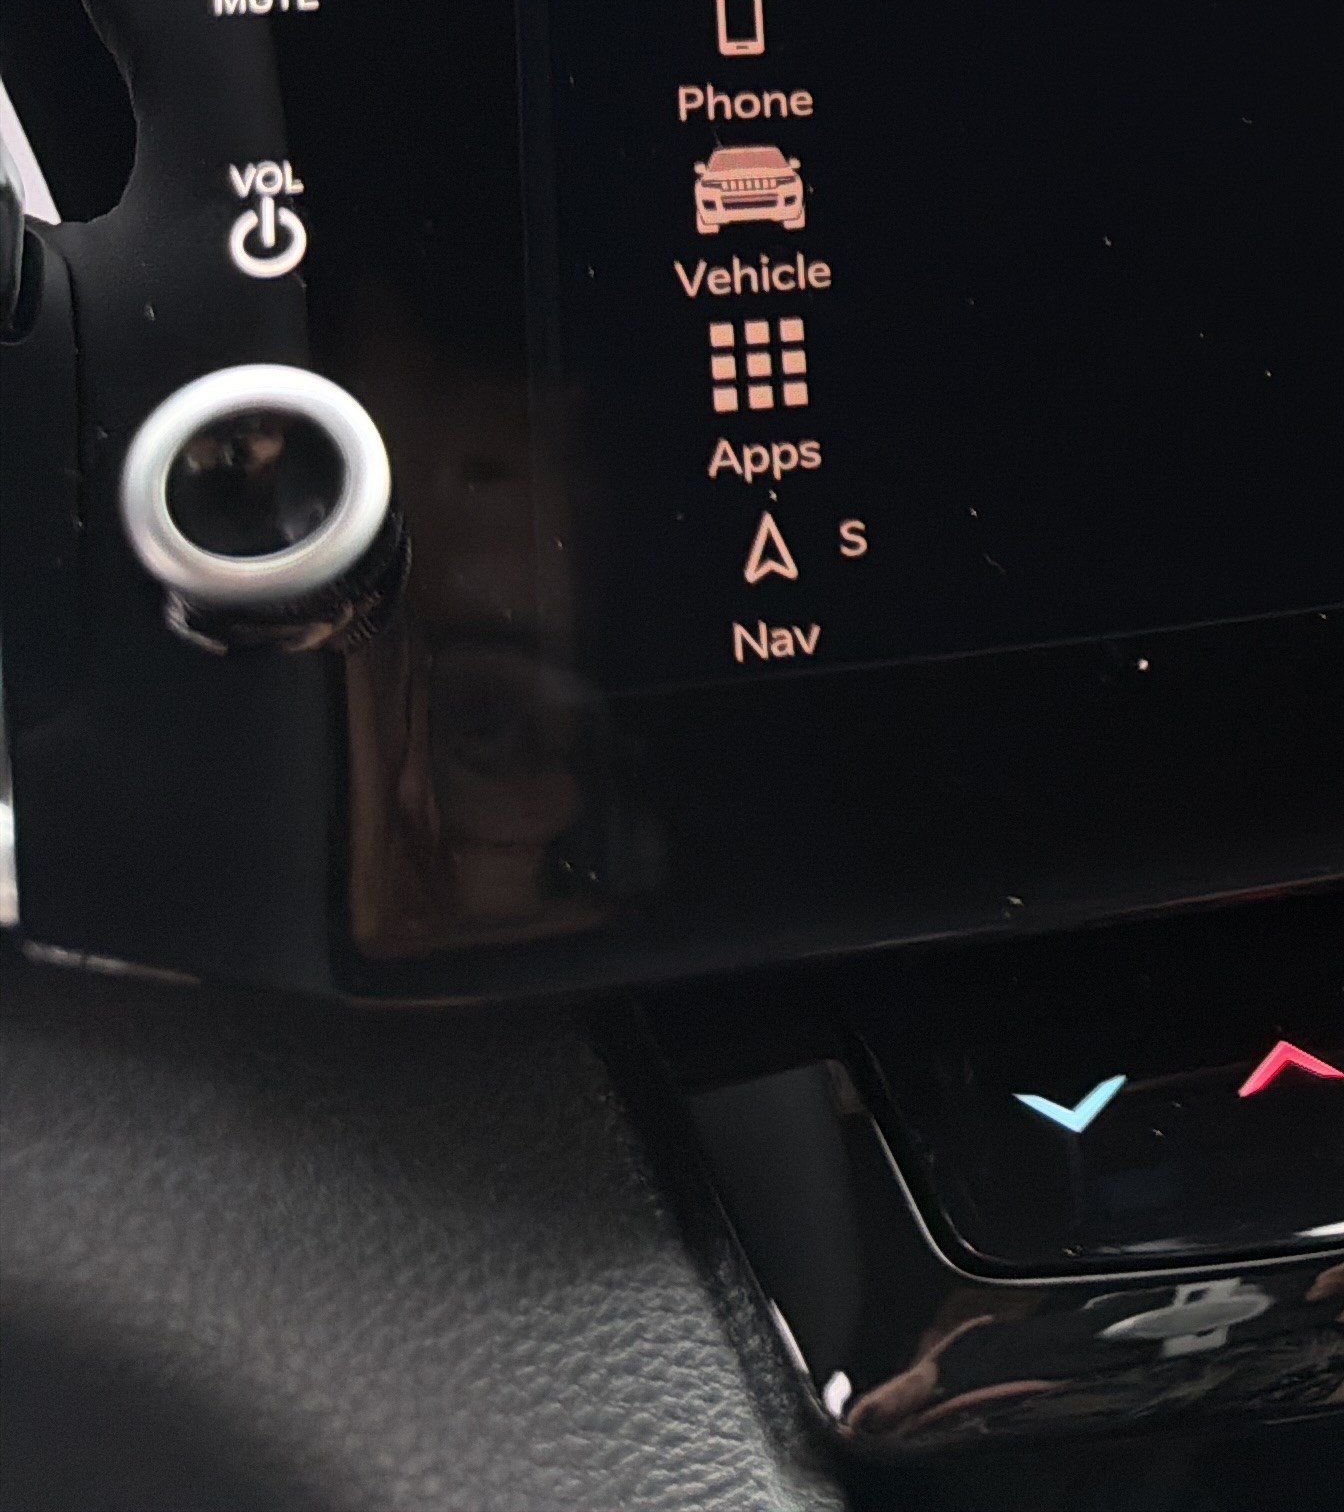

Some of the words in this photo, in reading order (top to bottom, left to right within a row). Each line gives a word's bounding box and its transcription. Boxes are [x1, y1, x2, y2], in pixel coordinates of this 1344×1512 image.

[678, 83, 814, 122] Phone
[230, 162, 304, 196] VOL
[674, 253, 832, 297] Vehicle
[708, 438, 822, 483] Apps
[839, 520, 868, 557] S
[733, 621, 821, 663] Nav
